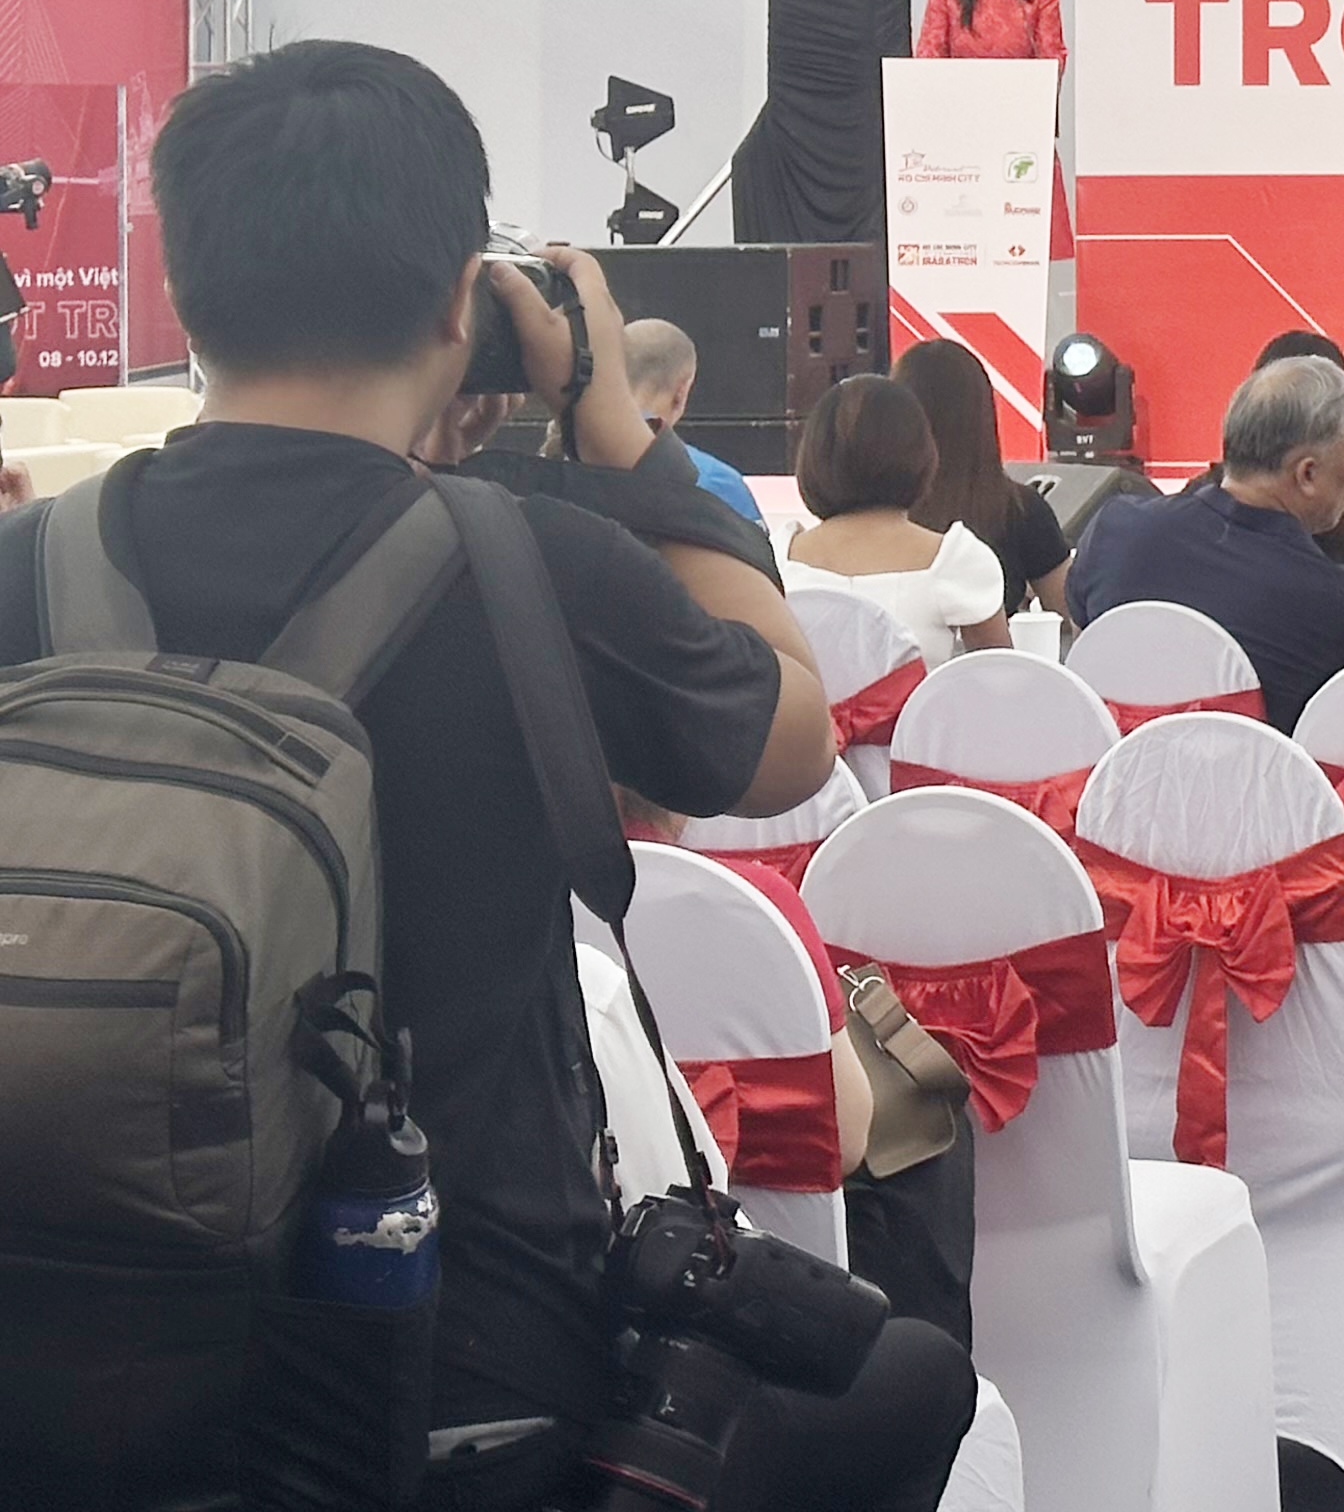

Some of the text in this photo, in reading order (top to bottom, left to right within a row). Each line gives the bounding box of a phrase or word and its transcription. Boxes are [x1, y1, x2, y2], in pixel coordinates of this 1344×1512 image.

[14, 267, 118, 291] vì một Việt
